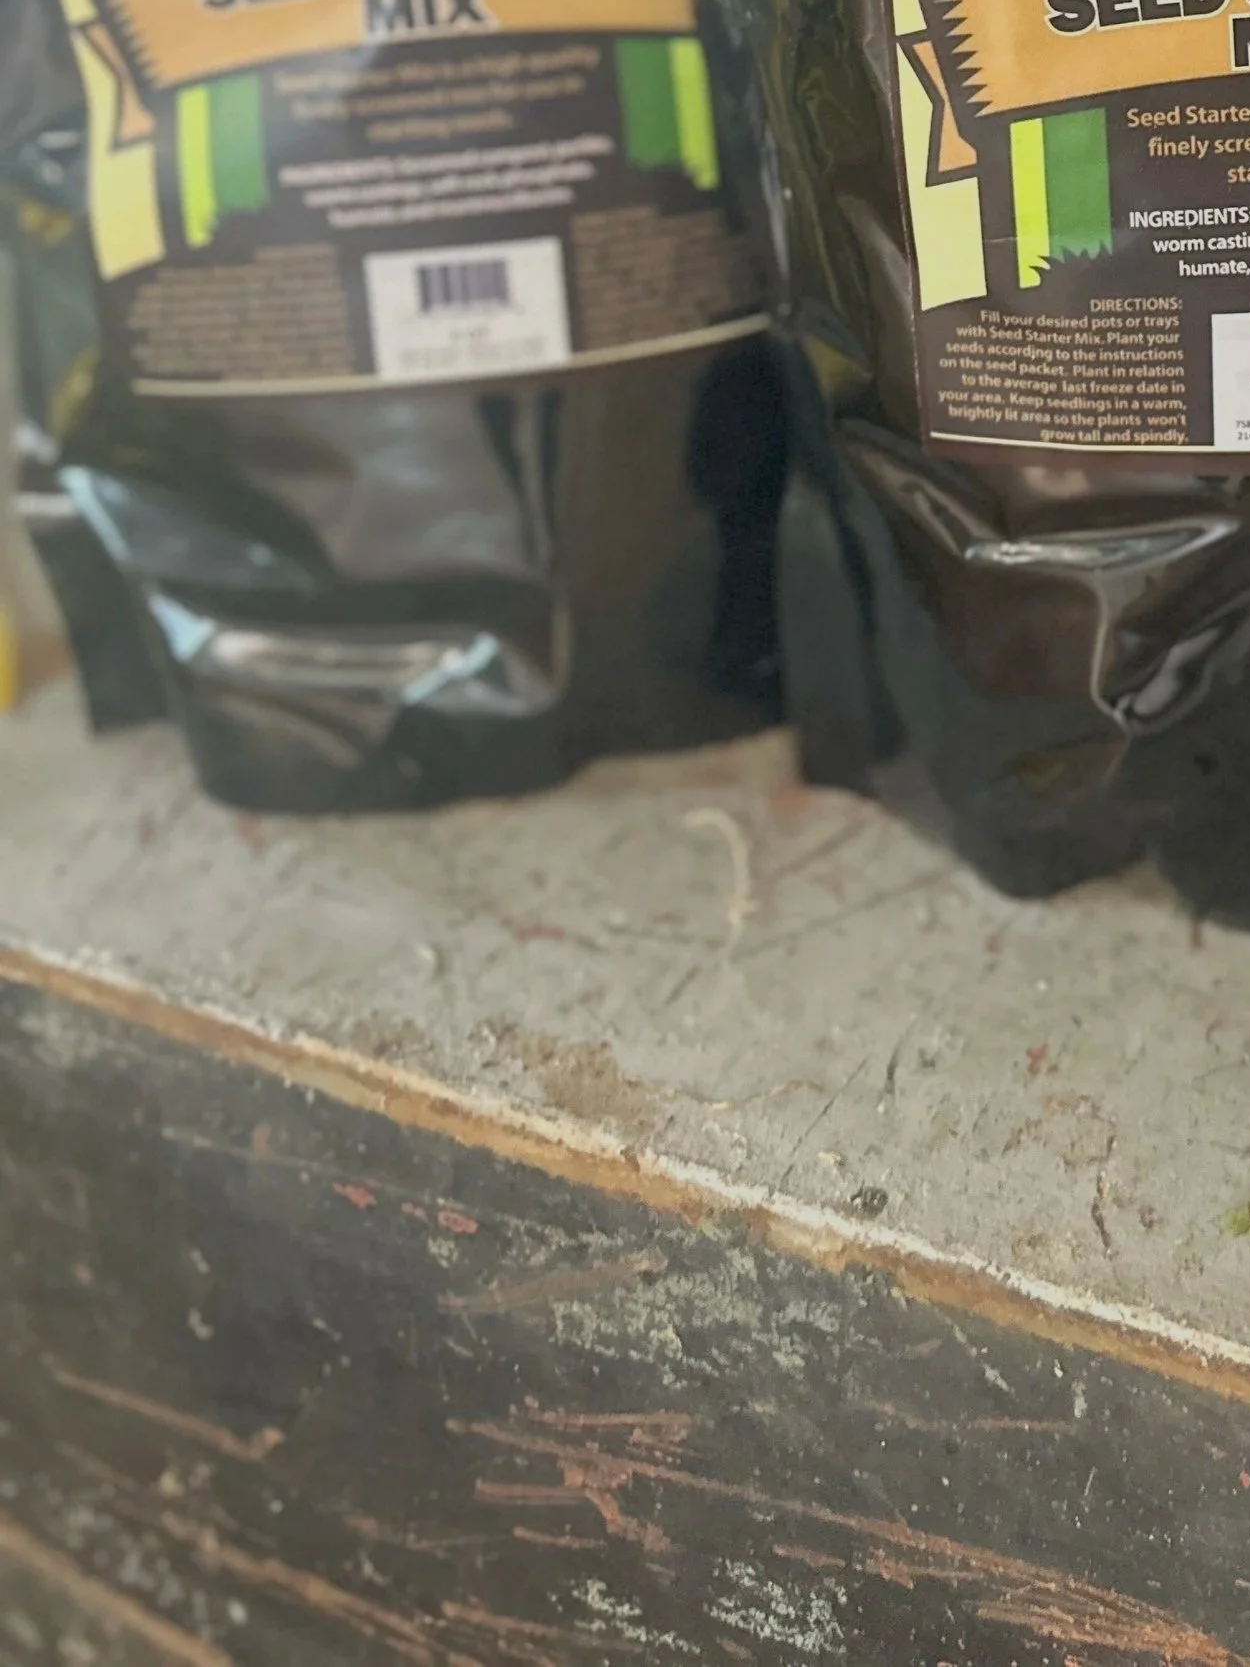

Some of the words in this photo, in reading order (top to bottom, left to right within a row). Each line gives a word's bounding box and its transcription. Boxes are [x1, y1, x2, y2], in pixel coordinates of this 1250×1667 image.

[1127, 107, 1180, 128] Seed
[1148, 135, 1210, 160] finely
[1153, 236, 1205, 254] worm
[1090, 296, 1183, 313] DIRECTIONS:
[980, 309, 1000, 323] Fill
[1003, 314, 1033, 327] your
[1036, 315, 1089, 330] desired
[1092, 315, 1123, 330] pots
[1125, 317, 1141, 328] or
[1144, 315, 1180, 329] trays
[955, 325, 987, 338] with
[990, 325, 1021, 340] Seed
[1026, 329, 1071, 344] Starter
[1075, 332, 1105, 346] Mix.
[1106, 332, 1144, 344] Plant
[1147, 333, 1180, 347] your
[945, 341, 985, 354] seeds
[987, 343, 1053, 361] according
[1055, 349, 1070, 361] to
[1073, 349, 1097, 361] the
[1099, 348, 1184, 361] instructions
[939, 359, 957, 368] on
[959, 357, 983, 369] the
[985, 360, 1016, 372] seed
[1019, 362, 1069, 376] packet.
[1073, 365, 1110, 377] Plant
[1113, 365, 1127, 377] in
[1129, 364, 1184, 377] relation
[961, 374, 976, 385] to
[978, 374, 1001, 386] the
[1003, 377, 1058, 394] average
[1062, 380, 1087, 392] last
[1089, 381, 1133, 394] freeze
[1136, 381, 1169, 393] date
[1171, 381, 1186, 393] in
[938, 390, 970, 402] your
[971, 392, 1006, 403] area.
[1009, 392, 1045, 408] Keep
[1047, 395, 1112, 412] seedlings
[1115, 398, 1129, 409] in
[1131, 401, 1140, 410] a
[1142, 400, 1187, 411] warm,
[947, 404, 1002, 422] brightly
[1004, 406, 1018, 420] lit
[1021, 411, 1051, 423] area
[1053, 414, 1070, 425] so
[1071, 413, 1094, 426] the
[1098, 413, 1142, 428] plants
[1040, 429, 1076, 443] grow
[1078, 428, 1101, 442] tall
[1103, 430, 1131, 442] and
[1133, 429, 1189, 446] spindly.
